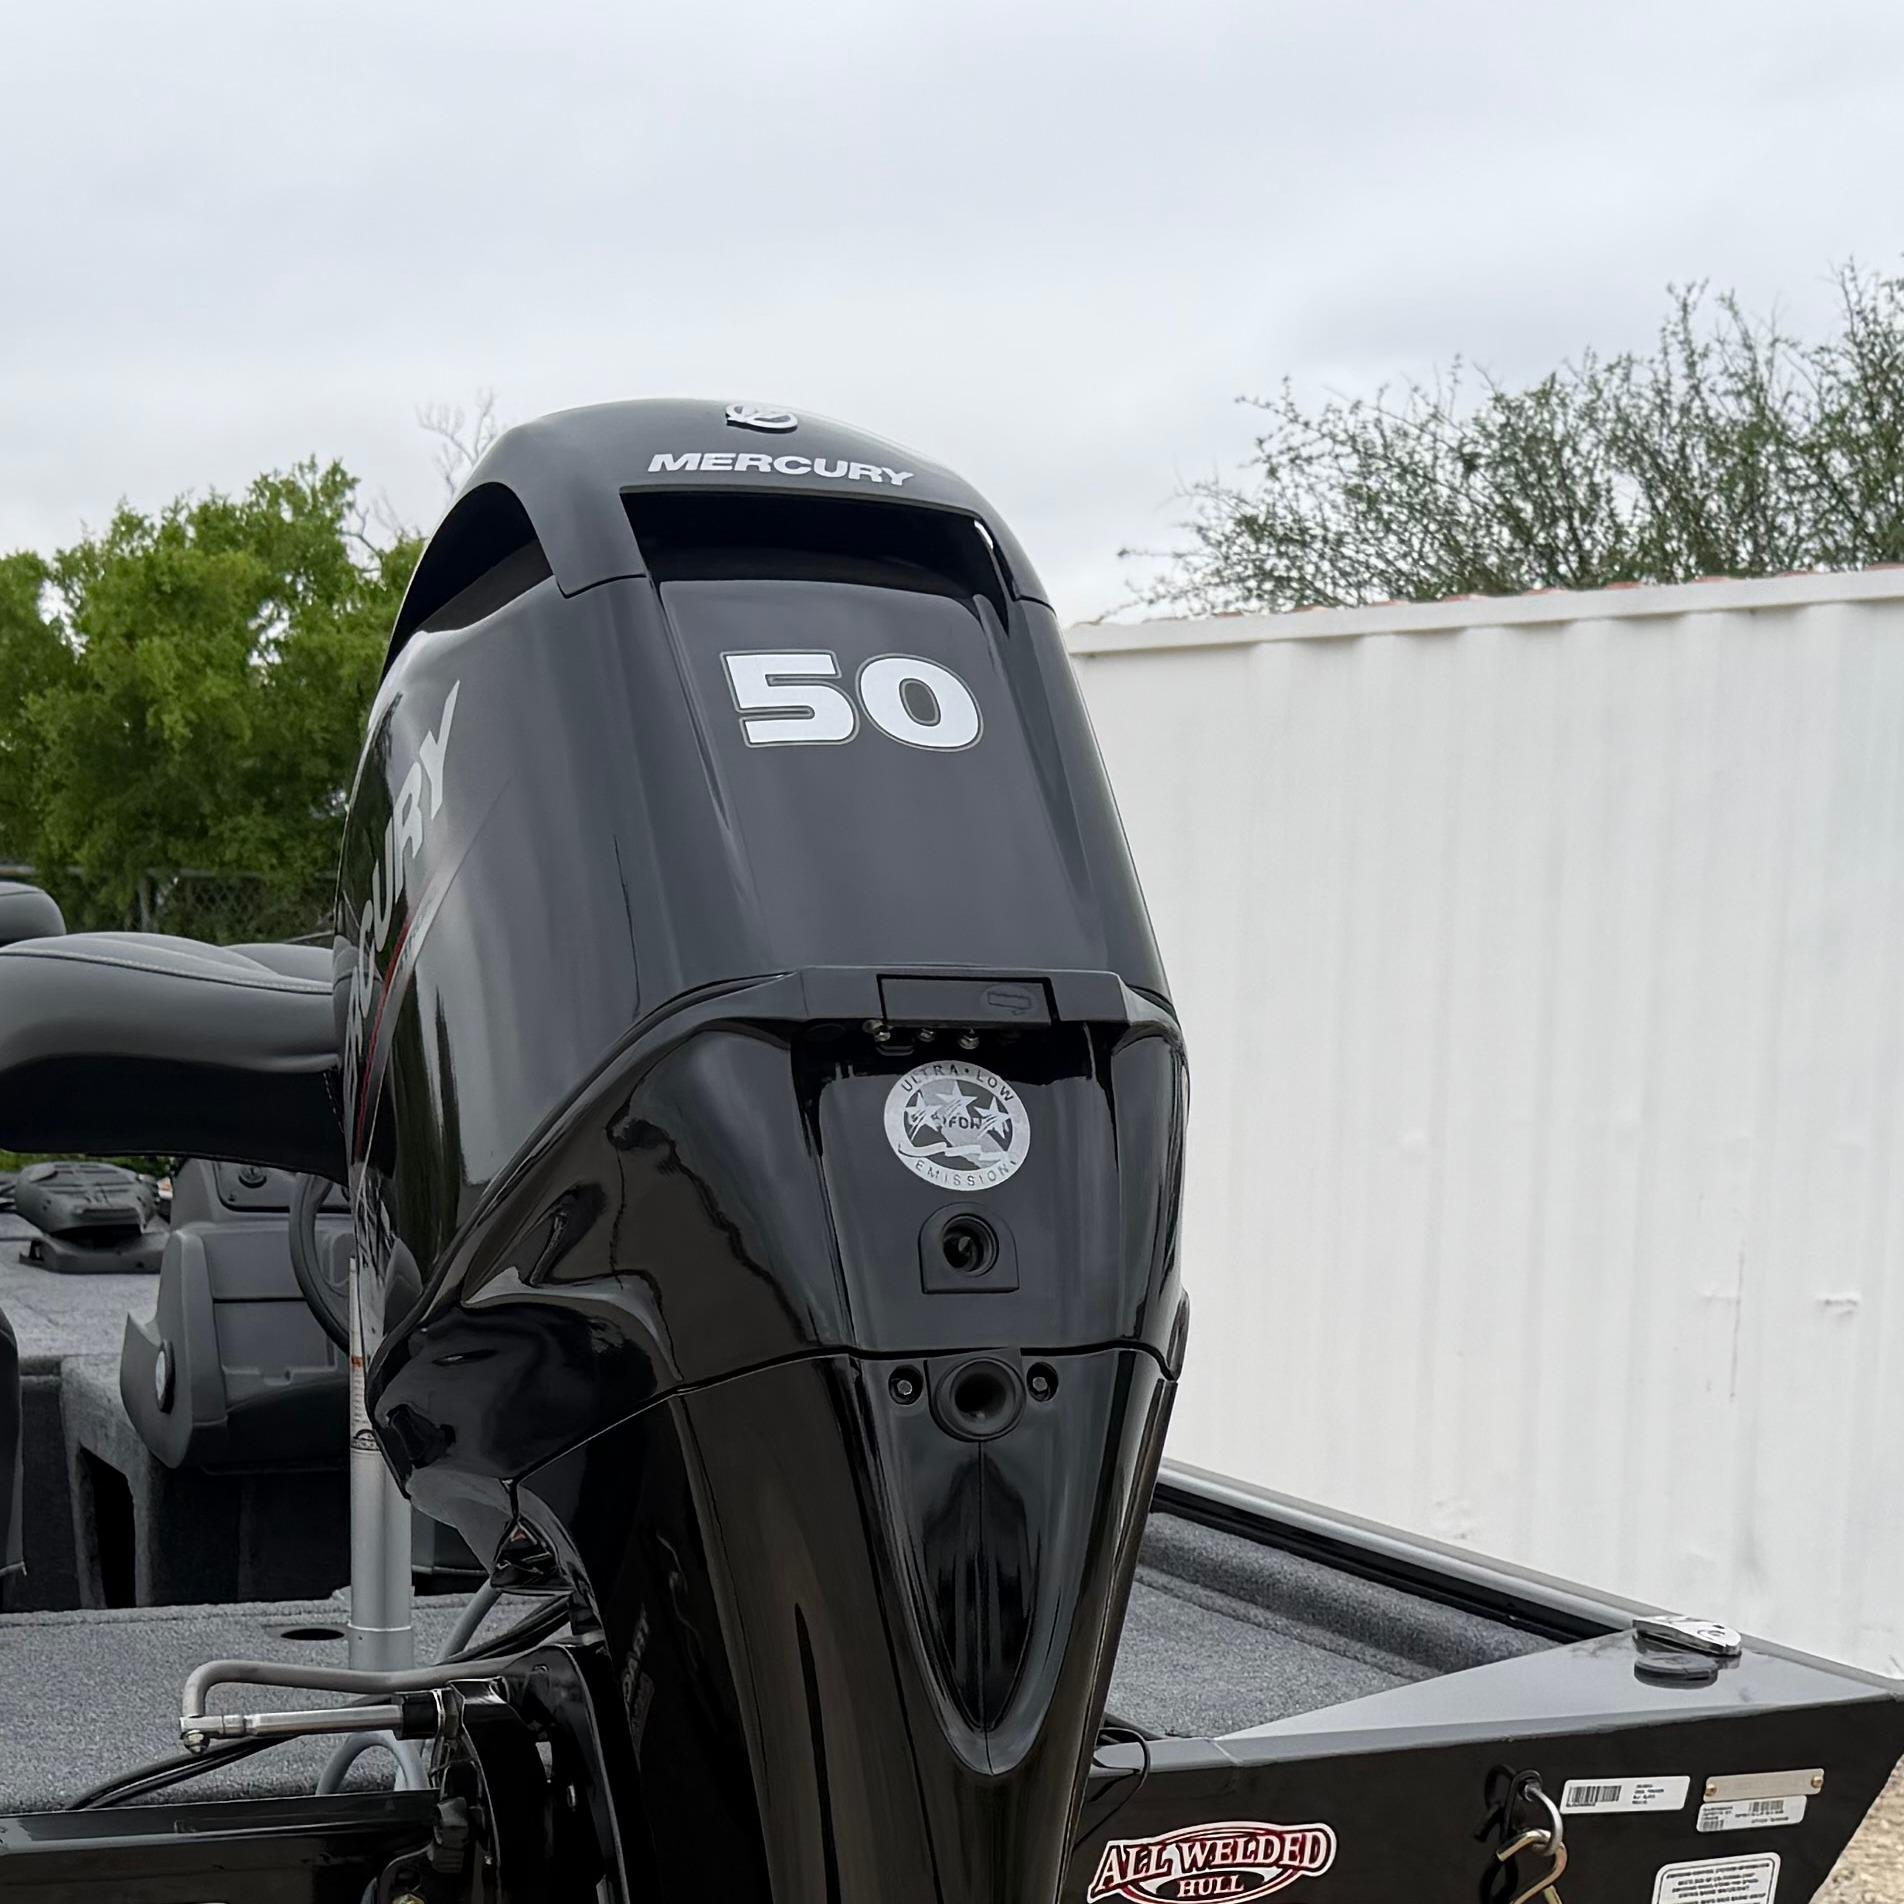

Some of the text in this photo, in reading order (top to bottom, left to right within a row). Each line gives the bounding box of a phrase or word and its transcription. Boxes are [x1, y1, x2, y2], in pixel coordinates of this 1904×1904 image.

[648, 452, 915, 486] MERCURY
[722, 650, 982, 751] 50
[900, 1063, 1014, 1102] ULTRA LOW
[915, 1159, 1010, 1187] EMISSION
[1096, 1831, 1328, 1891] ALL WELDED
[1178, 1874, 1245, 1898] HULL
